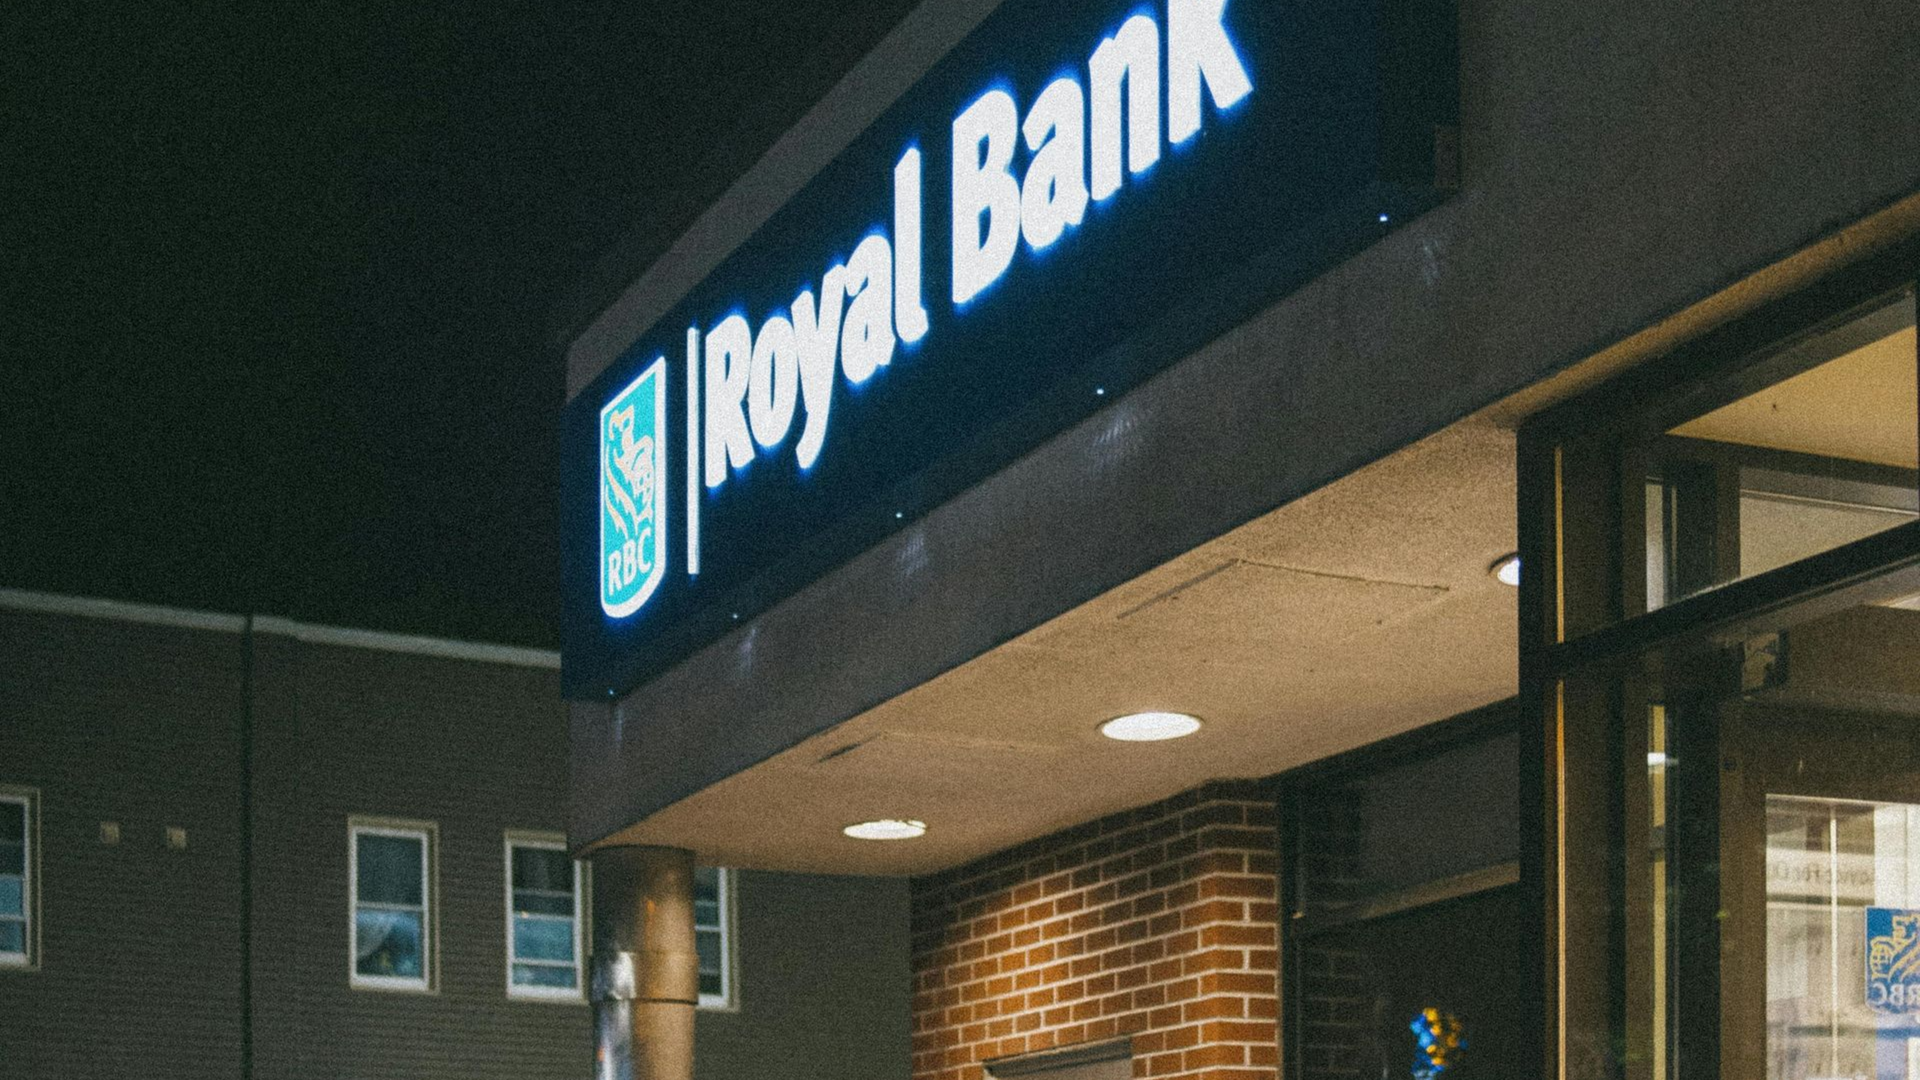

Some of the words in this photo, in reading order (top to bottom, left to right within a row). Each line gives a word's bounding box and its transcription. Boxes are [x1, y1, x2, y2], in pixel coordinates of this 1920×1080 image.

[704, 147, 929, 488] Royal
[951, 0, 1253, 304] Bank
[608, 526, 652, 597] RBC
